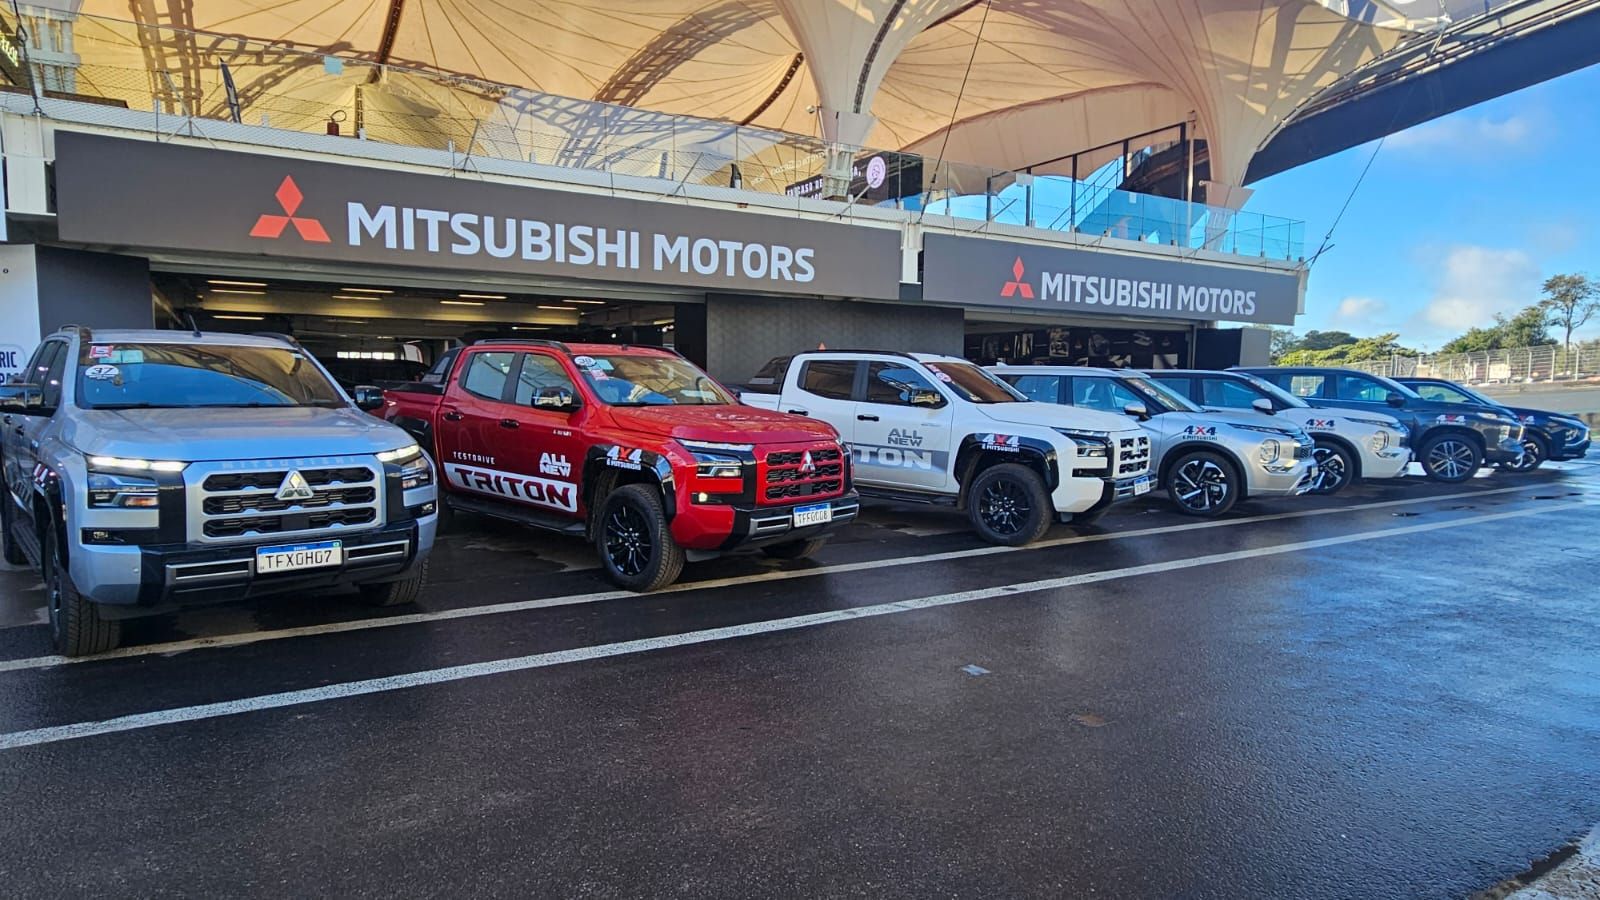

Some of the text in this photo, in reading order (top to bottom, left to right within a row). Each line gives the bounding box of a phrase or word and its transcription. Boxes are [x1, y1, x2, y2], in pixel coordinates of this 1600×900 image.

[347, 202, 816, 282] MITSUBISHI MOTORS
[1041, 271, 1256, 315] MITSUBISHI MOTORS
[888, 428, 923, 439] ALL
[888, 437, 922, 447] NEW
[453, 451, 495, 465] TESTDRIVE
[541, 452, 571, 467] ALL
[853, 447, 932, 469] TON
[540, 462, 571, 477] NEW
[455, 467, 571, 508] TRITON
